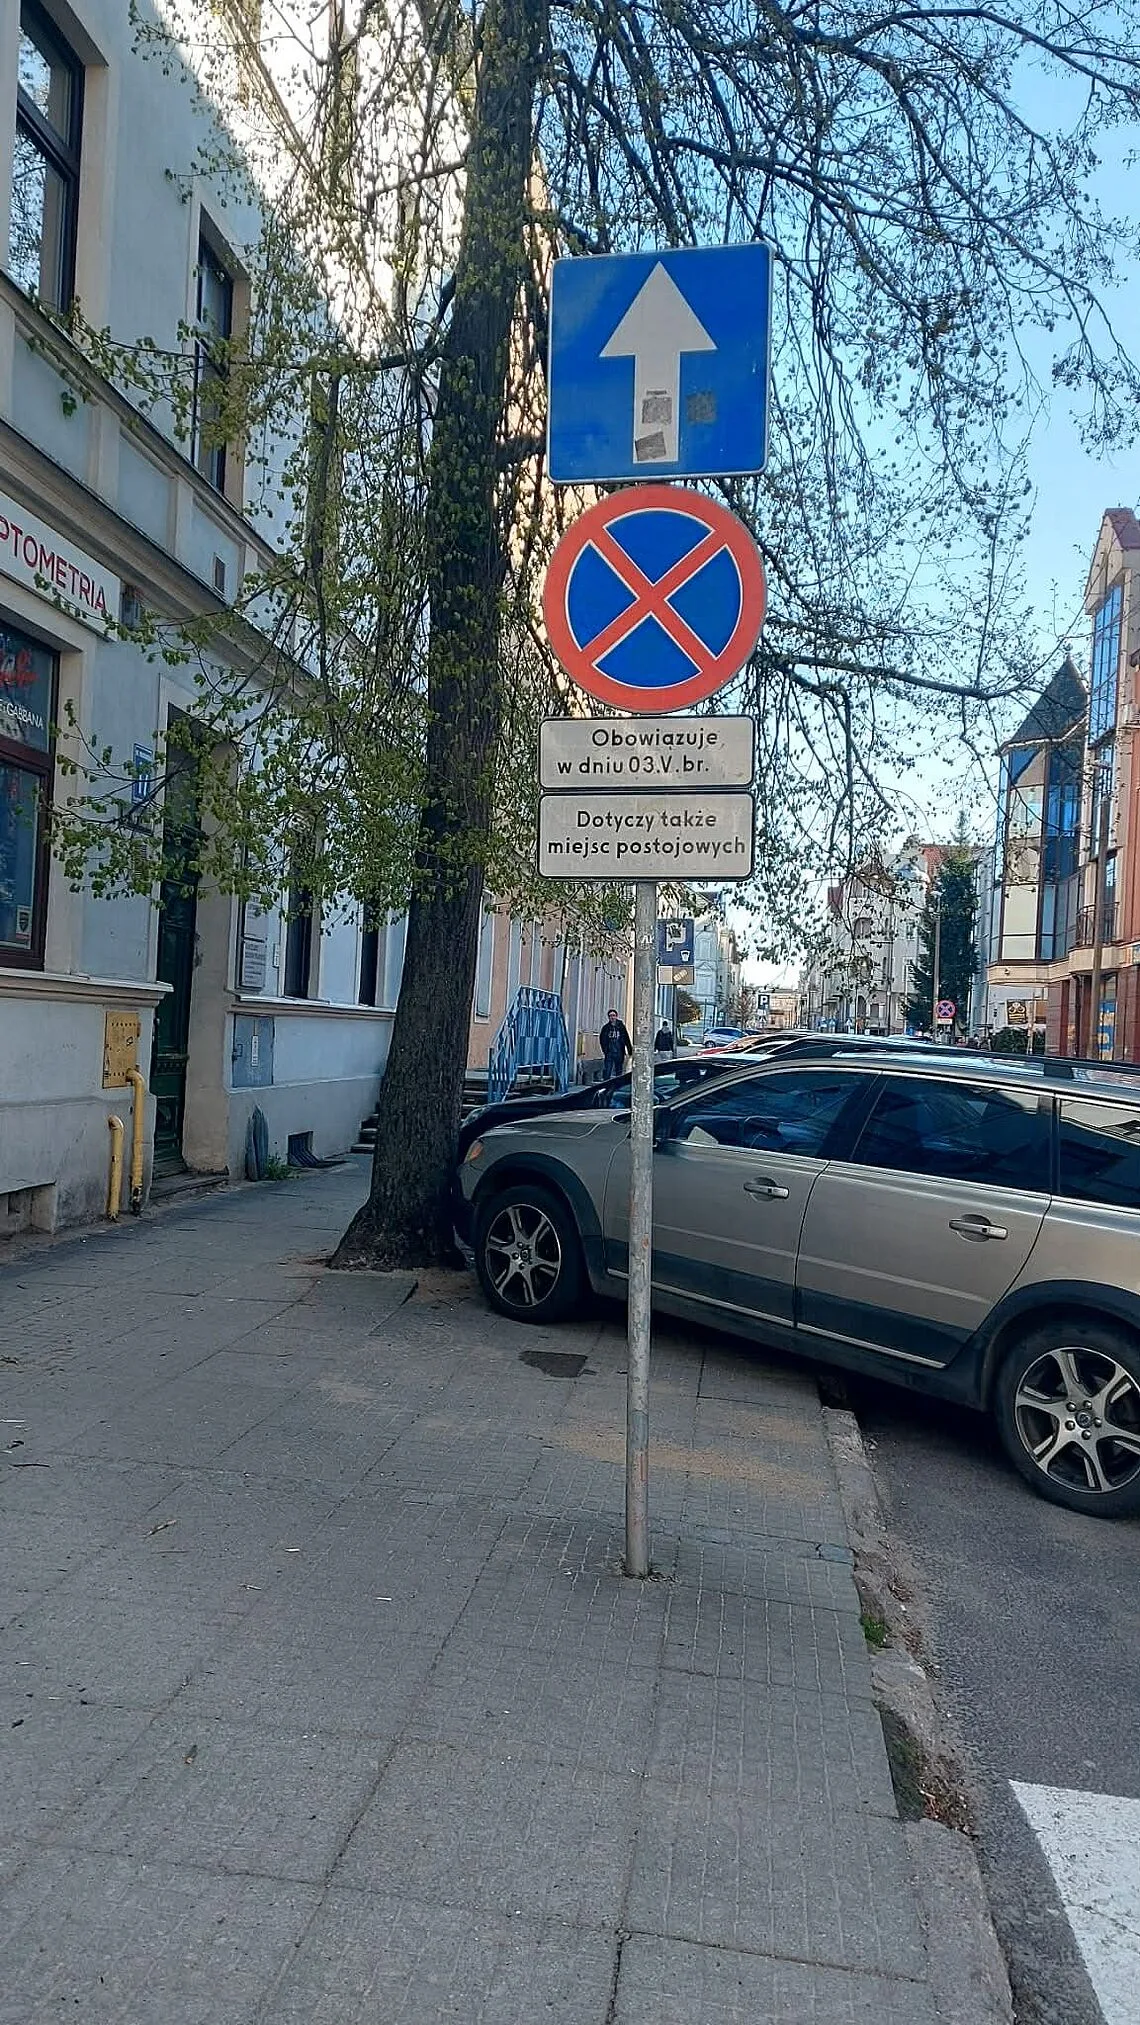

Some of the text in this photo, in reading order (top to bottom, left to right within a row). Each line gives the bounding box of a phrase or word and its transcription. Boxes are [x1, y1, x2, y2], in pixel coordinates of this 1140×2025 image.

[591, 727, 719, 750] Obowiązuje
[557, 760, 572, 774] w
[578, 756, 623, 774] dniu
[576, 809, 717, 832] Dotyczy także
[548, 836, 746, 859] miejsc postojowych
